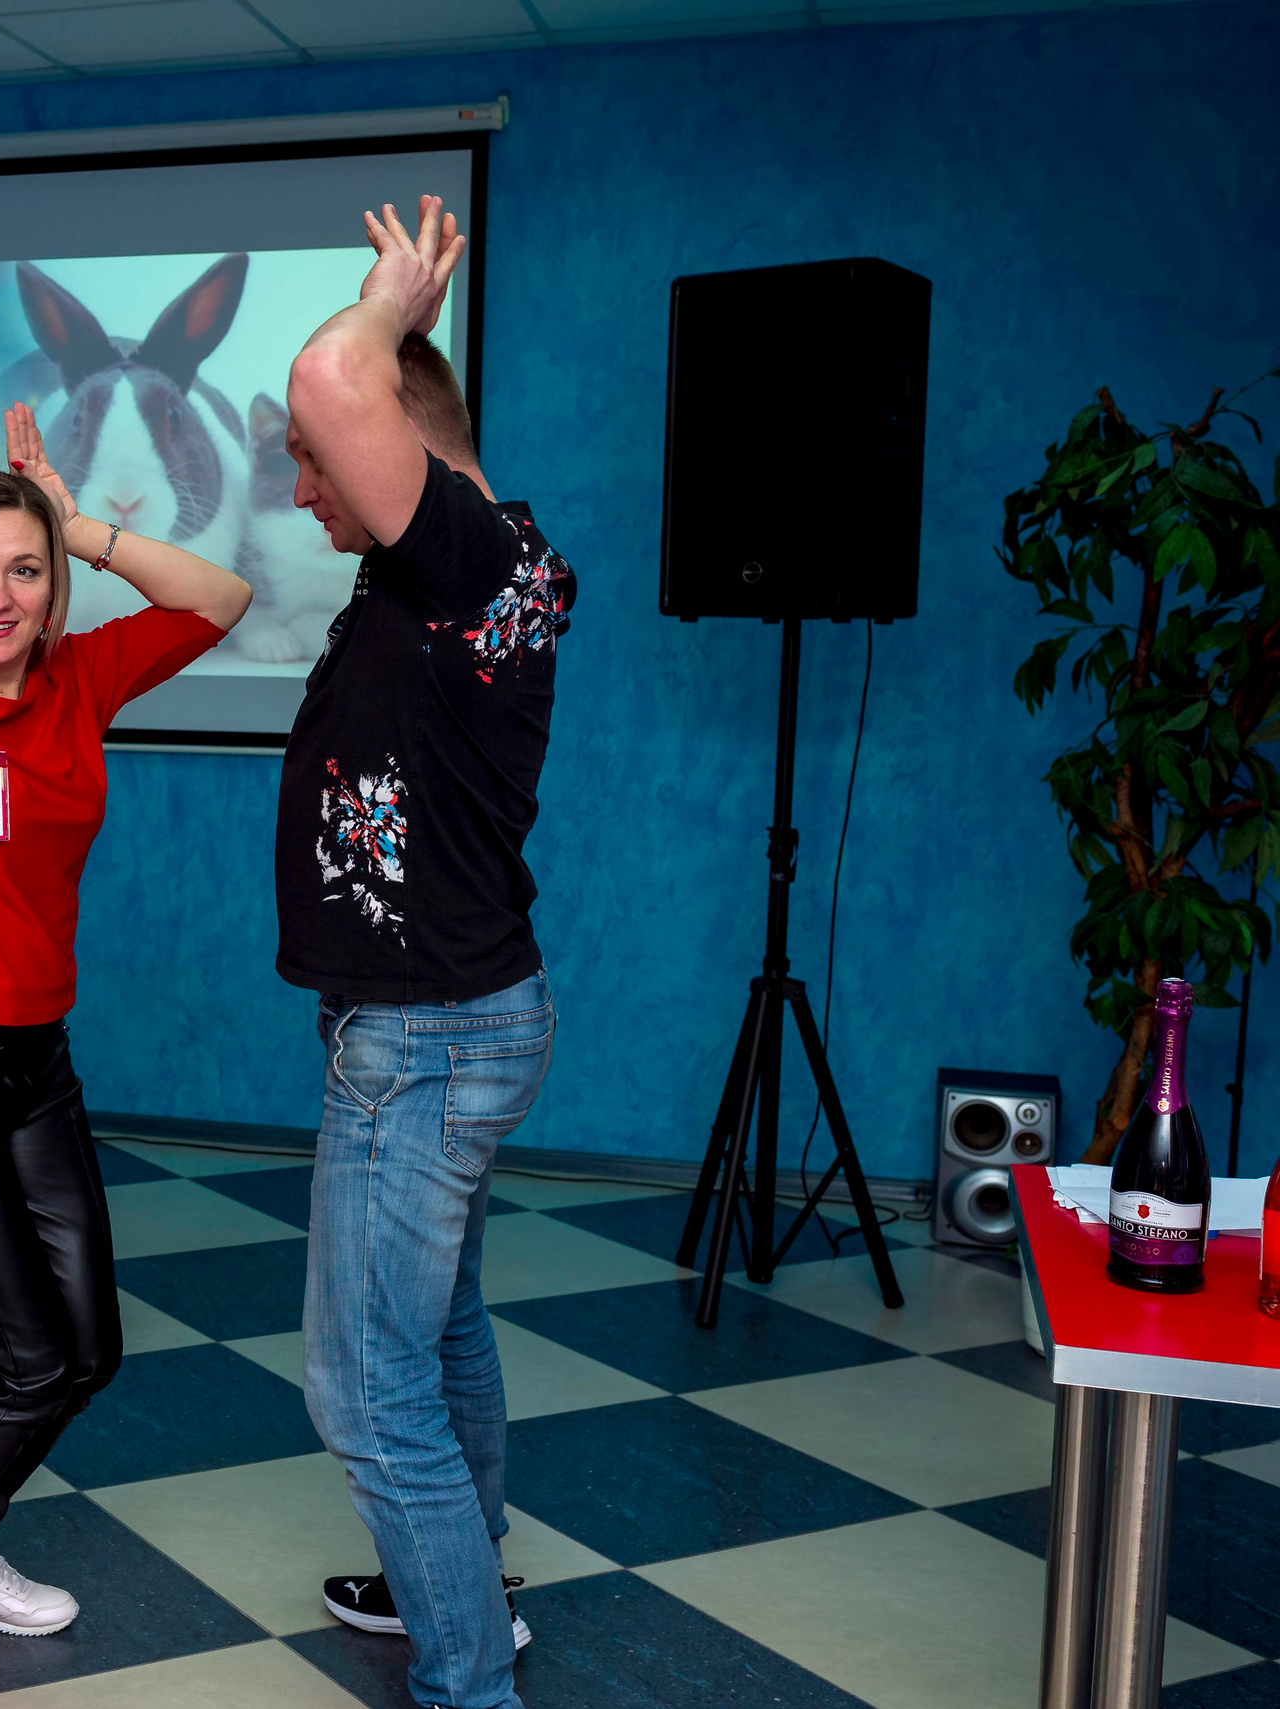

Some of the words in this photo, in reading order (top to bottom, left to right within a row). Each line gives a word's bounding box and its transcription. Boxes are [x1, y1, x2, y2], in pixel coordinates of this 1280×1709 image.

[1164, 1029, 1175, 1066] STEFANO
[1160, 1067, 1172, 1095] SANTO
[1110, 1215, 1134, 1232] SANTO
[1138, 1225, 1188, 1240] STEFANO
